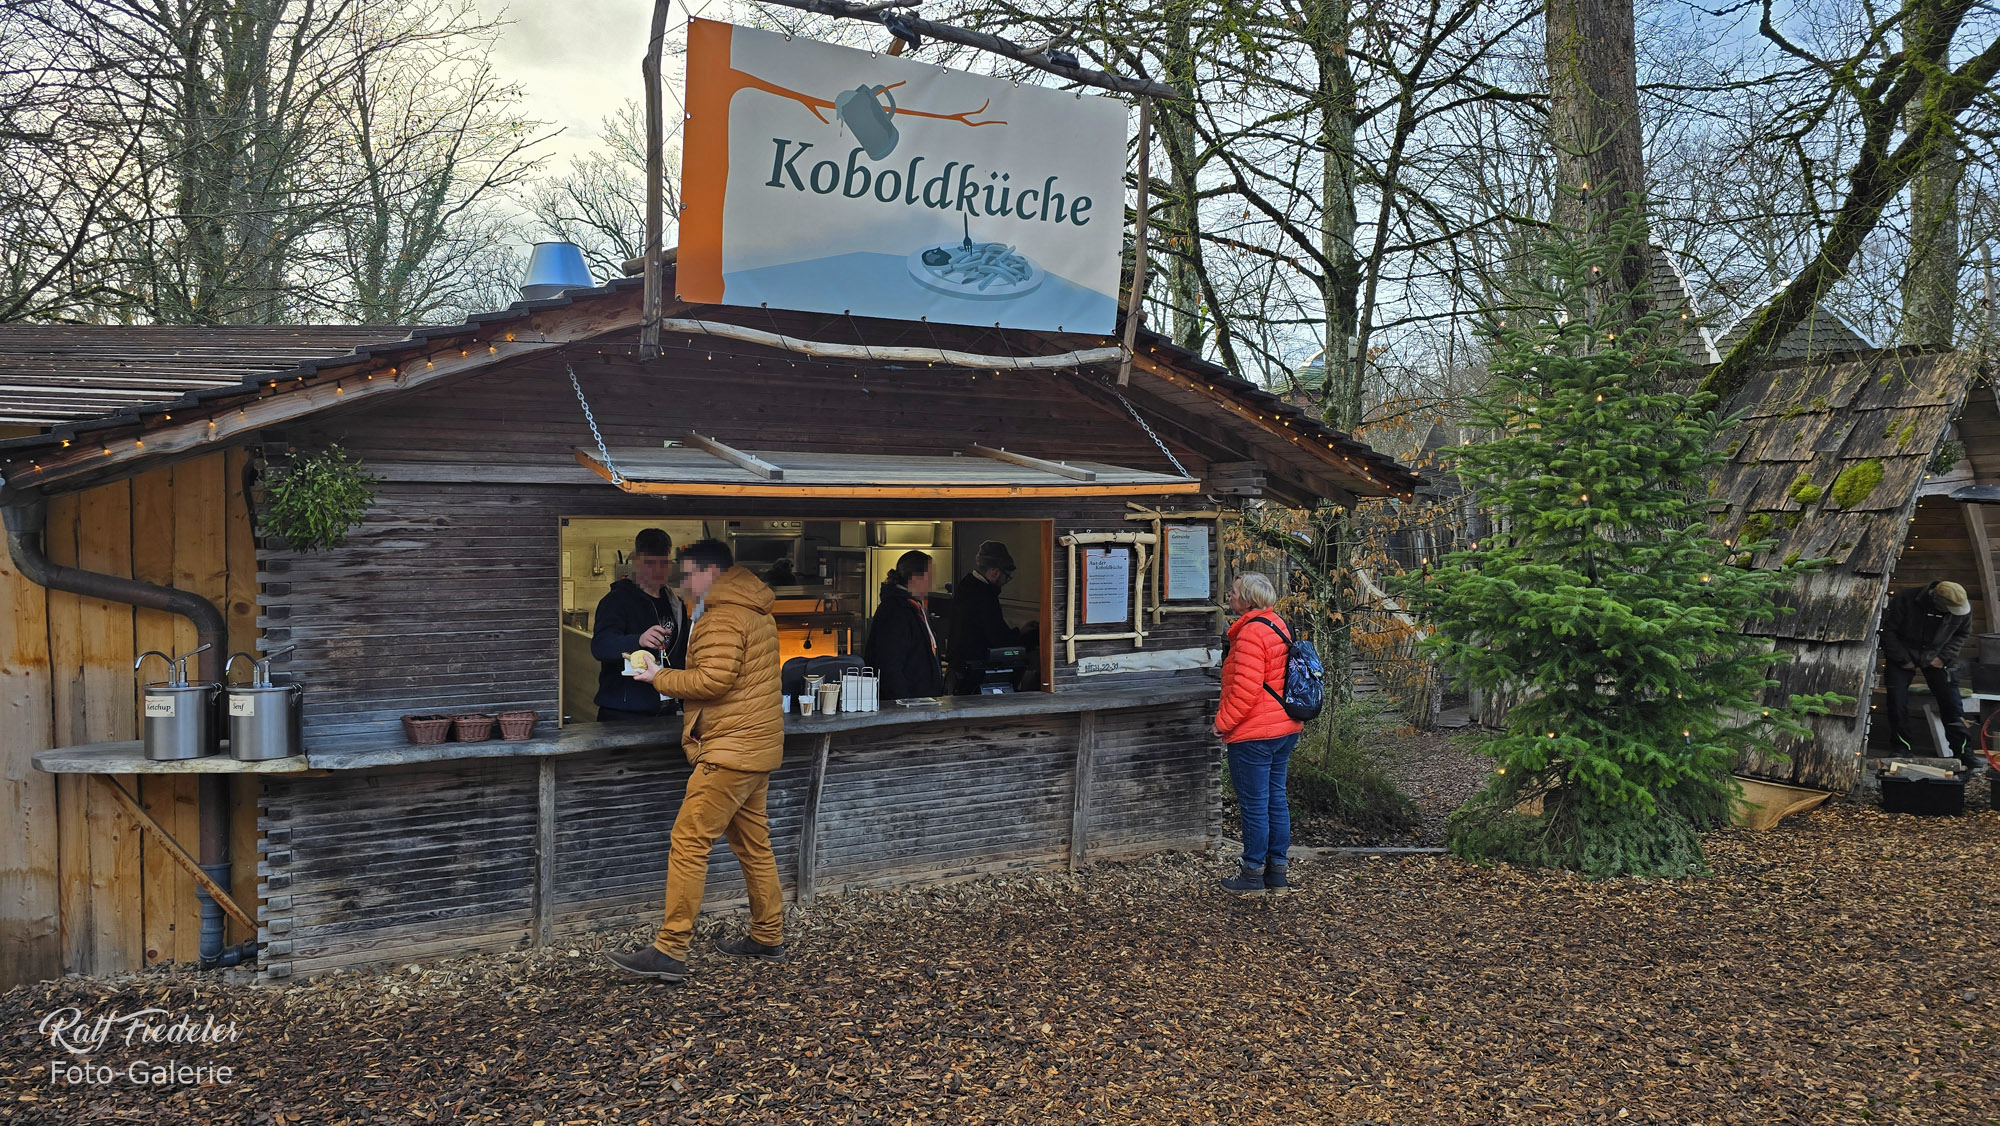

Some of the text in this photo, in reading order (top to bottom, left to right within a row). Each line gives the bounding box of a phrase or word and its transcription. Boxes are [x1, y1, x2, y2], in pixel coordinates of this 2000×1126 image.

[765, 137, 1093, 226] Koboldküche
[146, 703, 172, 713] Ketchup
[232, 701, 245, 712] Senf
